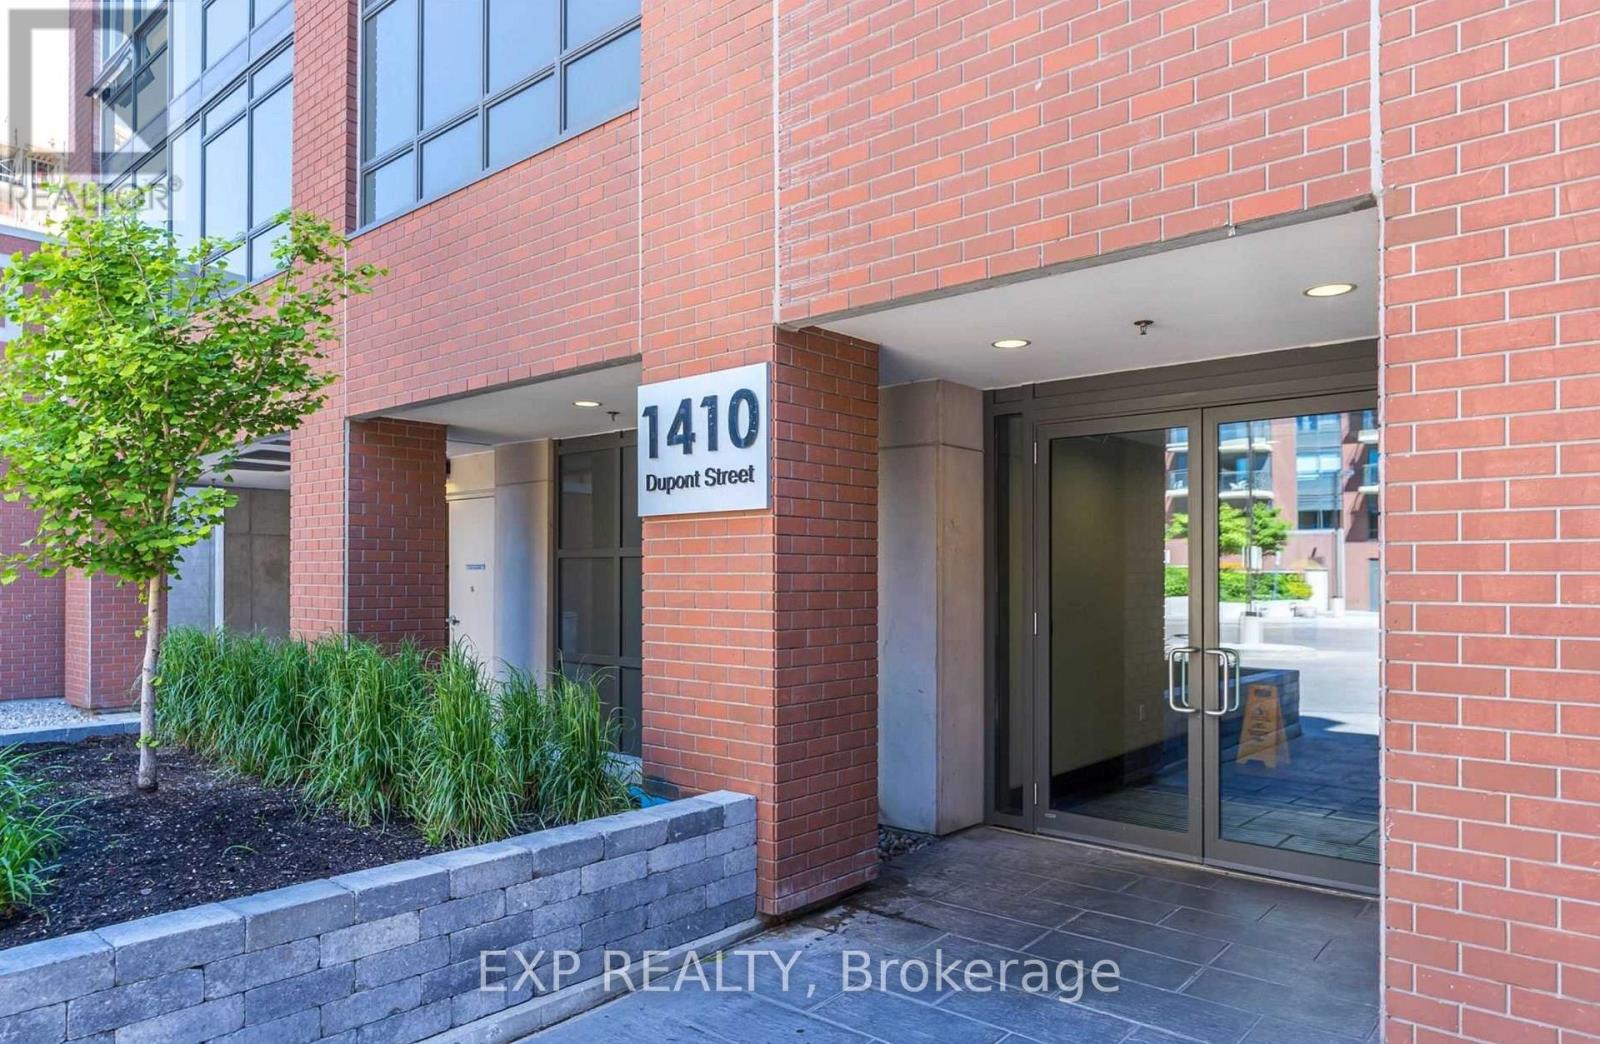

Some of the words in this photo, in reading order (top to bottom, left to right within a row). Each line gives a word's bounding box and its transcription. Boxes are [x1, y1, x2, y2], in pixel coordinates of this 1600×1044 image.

[642, 388, 760, 459] 1410
[646, 470, 700, 495] Dupont
[704, 464, 755, 487] Street
